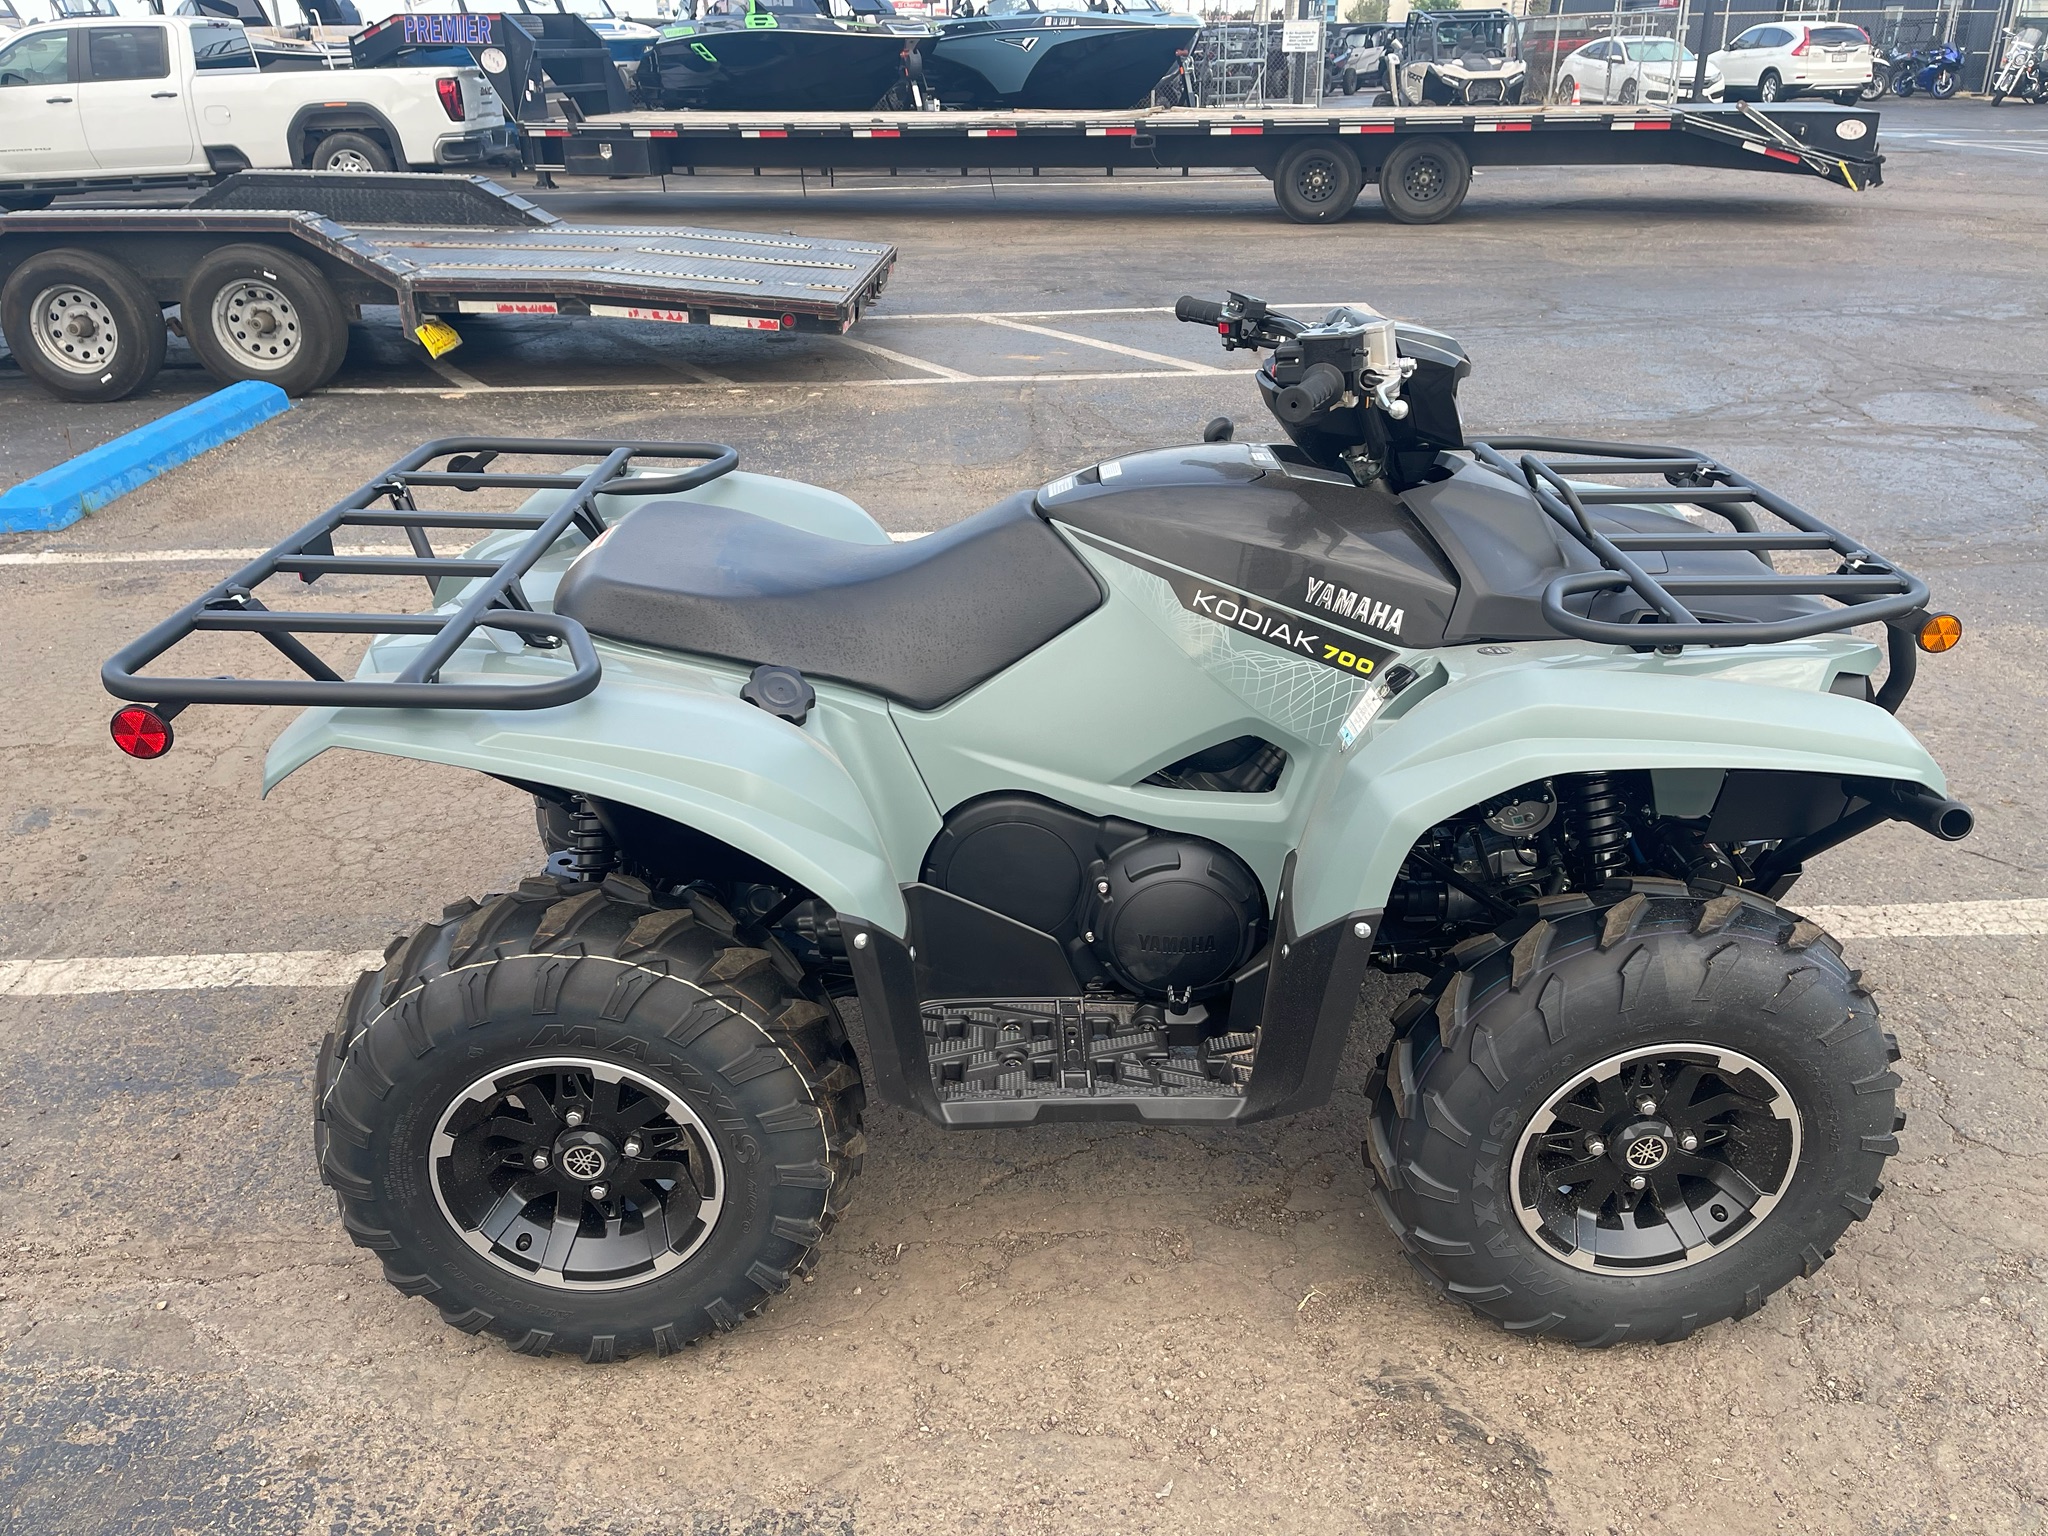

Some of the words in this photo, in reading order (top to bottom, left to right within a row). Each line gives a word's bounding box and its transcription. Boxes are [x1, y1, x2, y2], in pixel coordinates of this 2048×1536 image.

[404, 15, 493, 44] PREMIER
[1192, 589, 1320, 654] KODIAK
[1322, 644, 1375, 675] 700
[1304, 576, 1405, 635] YAMAHA
[1137, 932, 1217, 955] YAMAHA
[526, 1023, 761, 1165] MAXXIS
[1471, 1107, 1573, 1296] MAXXIS
